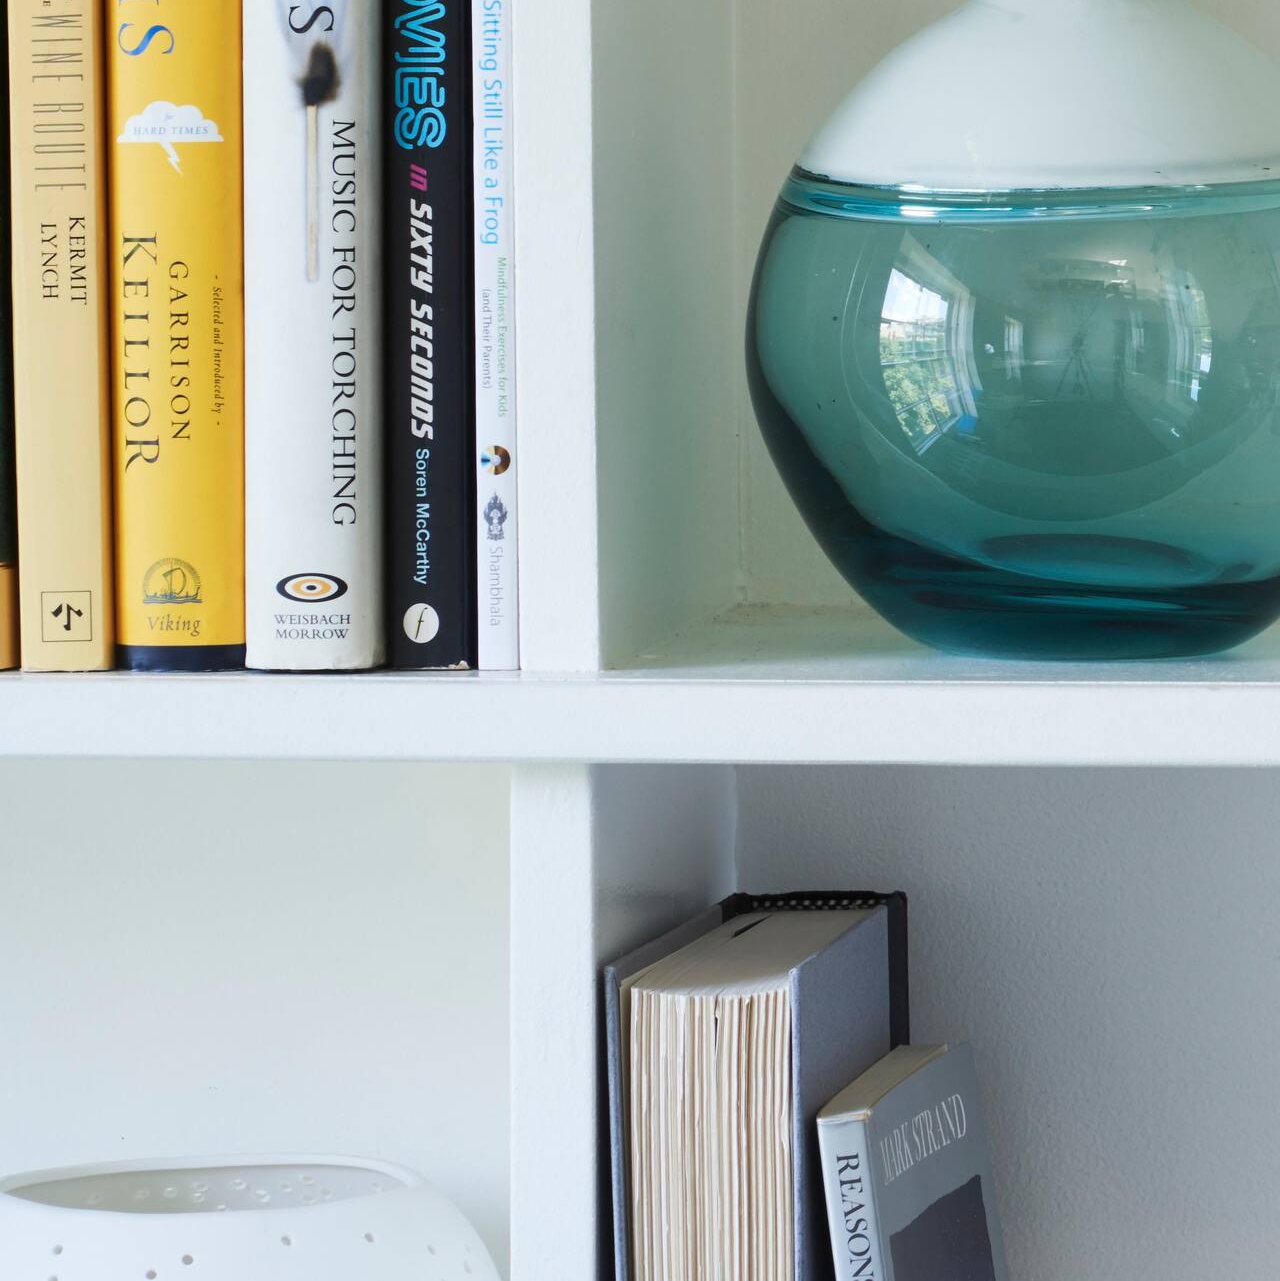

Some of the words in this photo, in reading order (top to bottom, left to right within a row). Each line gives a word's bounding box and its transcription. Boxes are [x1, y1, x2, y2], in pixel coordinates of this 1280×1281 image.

[31, 14, 83, 82] WINE
[479, 0, 502, 72] Sitting
[133, 125, 166, 135] HARD
[172, 125, 209, 135] TIMES
[484, 80, 503, 119] Still
[32, 103, 87, 191] ROUTE
[332, 120, 356, 233] MUSIC
[484, 127, 503, 170] Like
[484, 178, 498, 188] a
[410, 198, 433, 292] SIXTY
[480, 197, 503, 244] Frog
[40, 222, 59, 300] LYNCH
[68, 216, 88, 305] KERMIT
[332, 246, 356, 320] FOR
[212, 286, 224, 324] Selected
[213, 327, 224, 344] and
[121, 230, 161, 472] KEILLOR
[168, 260, 191, 441] GARRISON
[213, 348, 225, 400] Introduced
[410, 297, 433, 442] SECONDS
[211, 403, 225, 414] by
[332, 327, 357, 527] TORCHING
[415, 447, 429, 497] Soren
[414, 502, 430, 586] McCarthy
[274, 614, 350, 626] WEISBACH
[489, 546, 503, 626] Shambhala
[147, 615, 201, 636] Viking
[275, 629, 349, 640] MORROW
[912, 1094, 967, 1161] STRAND
[836, 1151, 875, 1281] REASON
